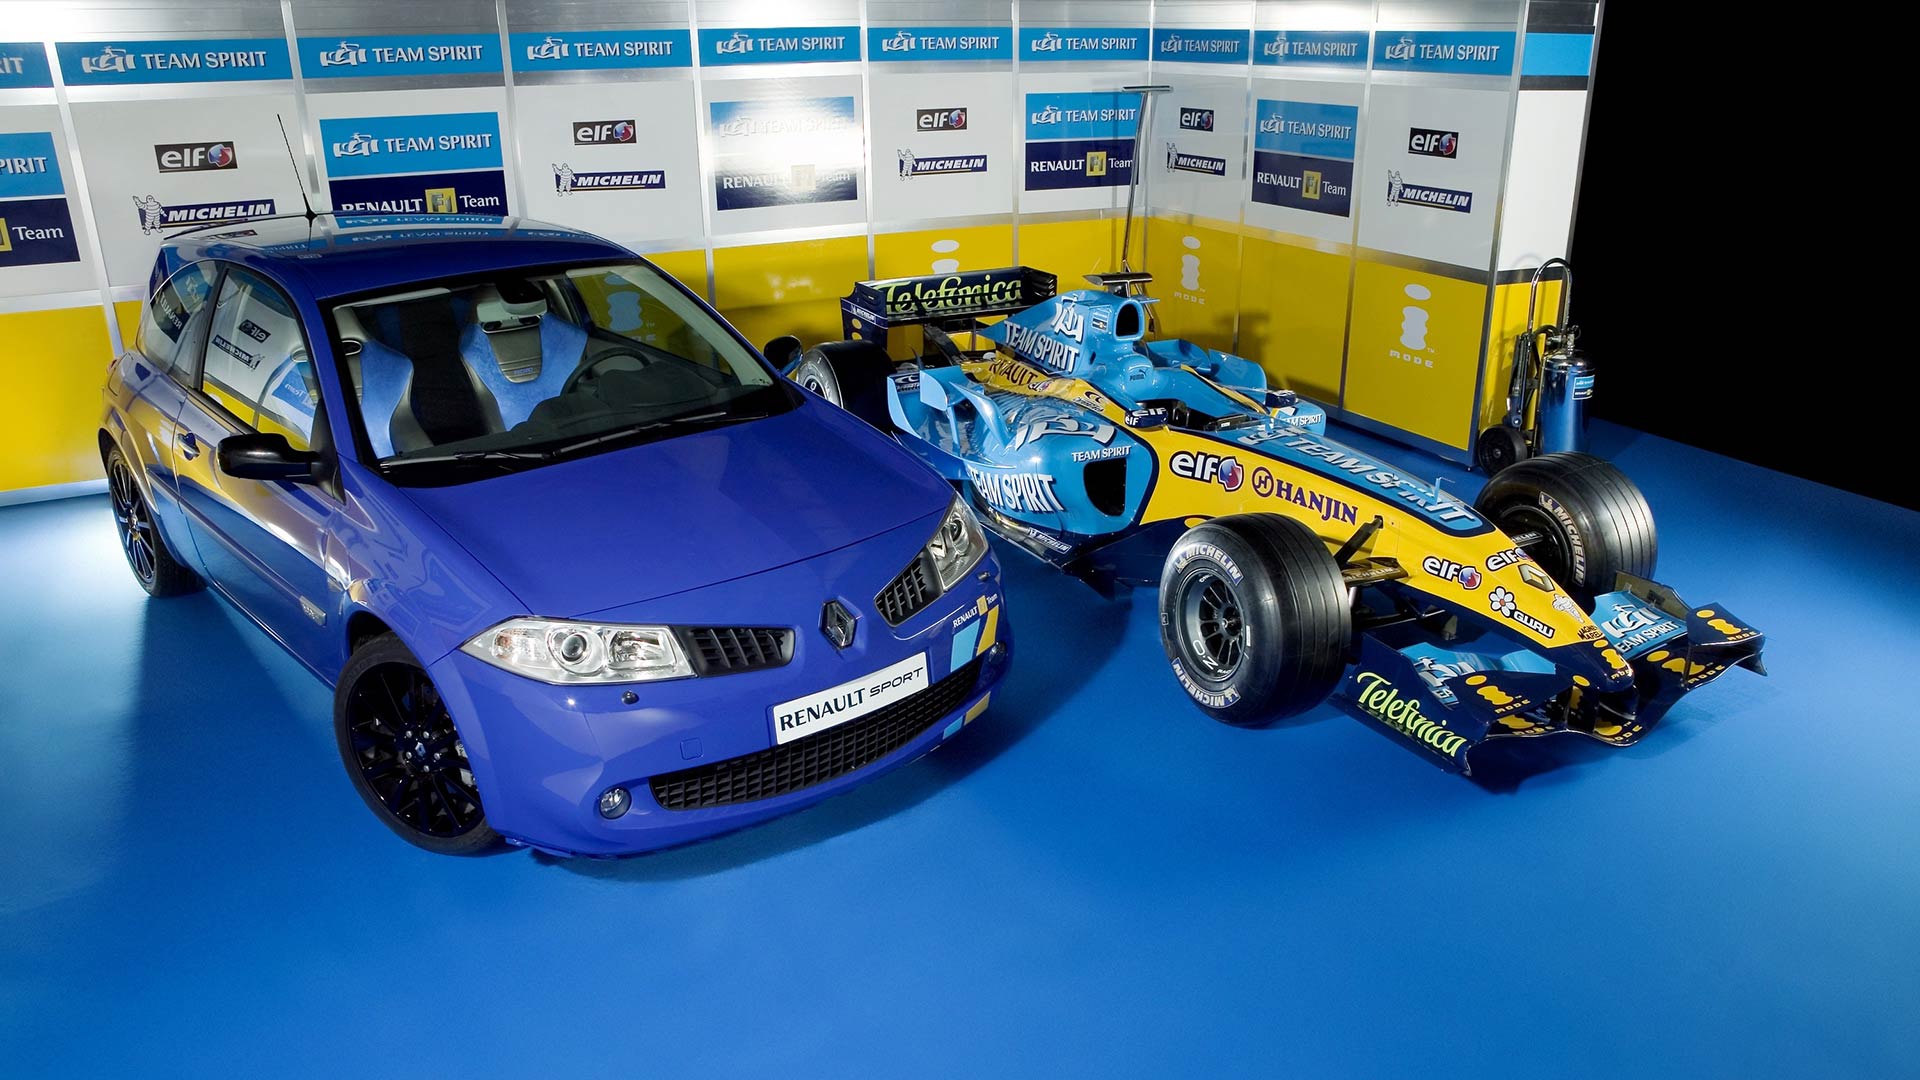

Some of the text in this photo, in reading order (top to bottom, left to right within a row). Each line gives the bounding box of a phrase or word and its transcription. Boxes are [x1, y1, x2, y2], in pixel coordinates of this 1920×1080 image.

[573, 41, 674, 58] TEAM SPIRIT
[758, 36, 846, 52] TEAM SPIRIT
[919, 36, 1000, 51] TEAM SPIRIT
[1065, 37, 1138, 51] TEAM SPIRIT
[1183, 39, 1240, 54] TEAM SPIRIT
[1291, 43, 1359, 58] TEAM SPIRIT
[141, 50, 268, 71] TEAM SPIRIT
[372, 44, 484, 63] TEAM SPIRIT
[1419, 45, 1500, 63] TEAM SPIRIT
[918, 112, 949, 128] elf
[1065, 109, 1137, 123] TEAM SPIRIT
[1181, 112, 1201, 126] elf
[576, 125, 612, 143] elf
[1286, 121, 1352, 140] TEAM SPIRIT
[384, 133, 493, 153] TEAM SPIRIT
[1411, 133, 1440, 152] elf
[161, 148, 205, 168] elf
[915, 158, 986, 171] MICHELIN
[1030, 159, 1084, 173] RENAULT
[1177, 157, 1224, 172] MICHELIN
[576, 173, 662, 188] MICHELIN
[723, 175, 792, 189] RENAULT
[1256, 172, 1302, 190] RENAULT
[1322, 180, 1347, 197] Team
[459, 195, 500, 209] Team
[1403, 187, 1470, 208] MICHELIN
[167, 203, 271, 223] MICHELIN
[12, 226, 65, 242] Team
[1004, 320, 1080, 374] TEAM SPIRIT
[1389, 350, 1434, 368] MODE
[1125, 414, 1141, 426] elf
[1299, 413, 1322, 426] SPIRIT
[1071, 445, 1132, 463] TEAM SPIRIT
[1289, 433, 1371, 475] TEAM
[1170, 450, 1220, 484] elf
[967, 464, 1065, 512] TEAM SPIRIT
[1275, 479, 1359, 526] HANJIN
[1553, 505, 1585, 585] MICHELIN
[1185, 544, 1242, 580] MICHELIN
[1486, 549, 1521, 571] elf
[1423, 557, 1463, 582] elf
[952, 606, 978, 629] RENAULT
[1512, 610, 1555, 639] GURU
[1615, 620, 1680, 653] EAM SPIRIT
[1172, 663, 1226, 707] MICHELIN
[779, 666, 925, 732] RENAULT SPORT
[1494, 699, 1531, 714] MODE
